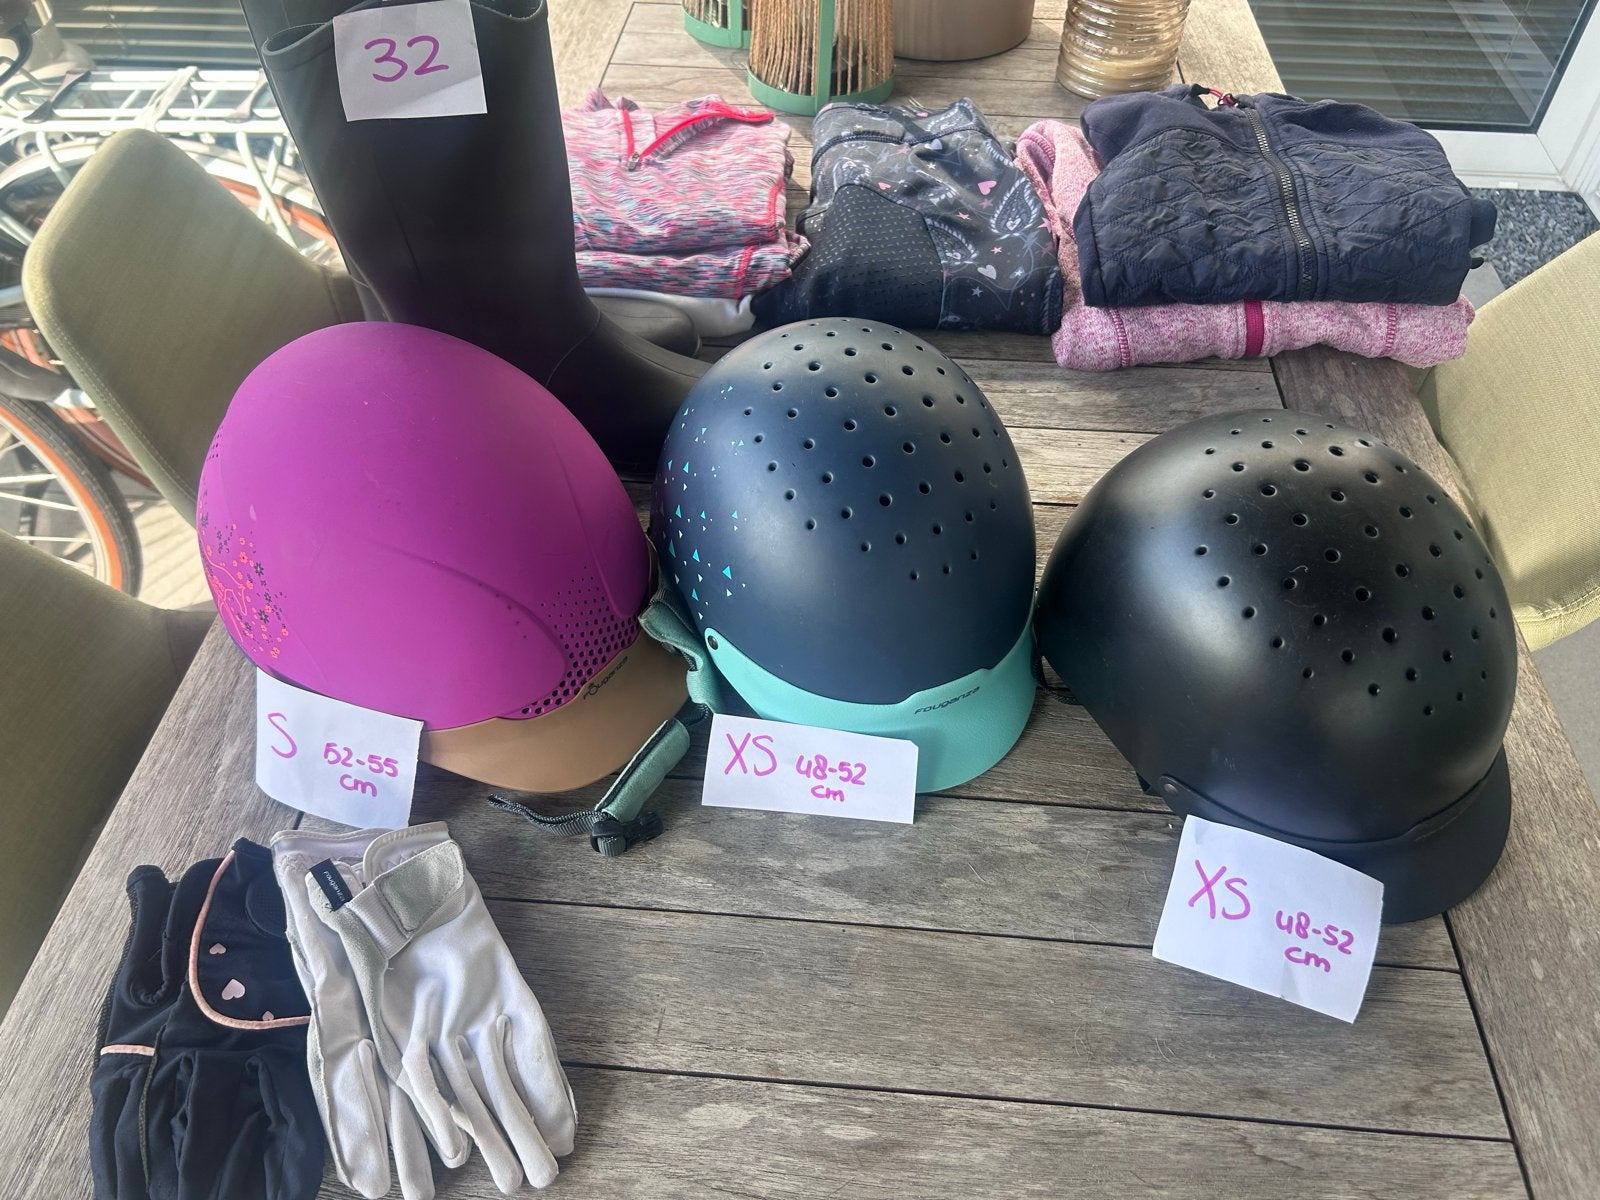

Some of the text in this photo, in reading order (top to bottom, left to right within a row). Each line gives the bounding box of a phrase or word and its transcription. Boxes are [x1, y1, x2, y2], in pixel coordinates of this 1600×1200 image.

[365, 34, 448, 82] 32
[268, 711, 399, 778] S 52-55
[724, 733, 867, 785] XS 48-52
[339, 773, 378, 797] cm
[810, 784, 846, 804] cm
[1187, 860, 1354, 956] XS 48-52
[1286, 946, 1332, 972] cm
